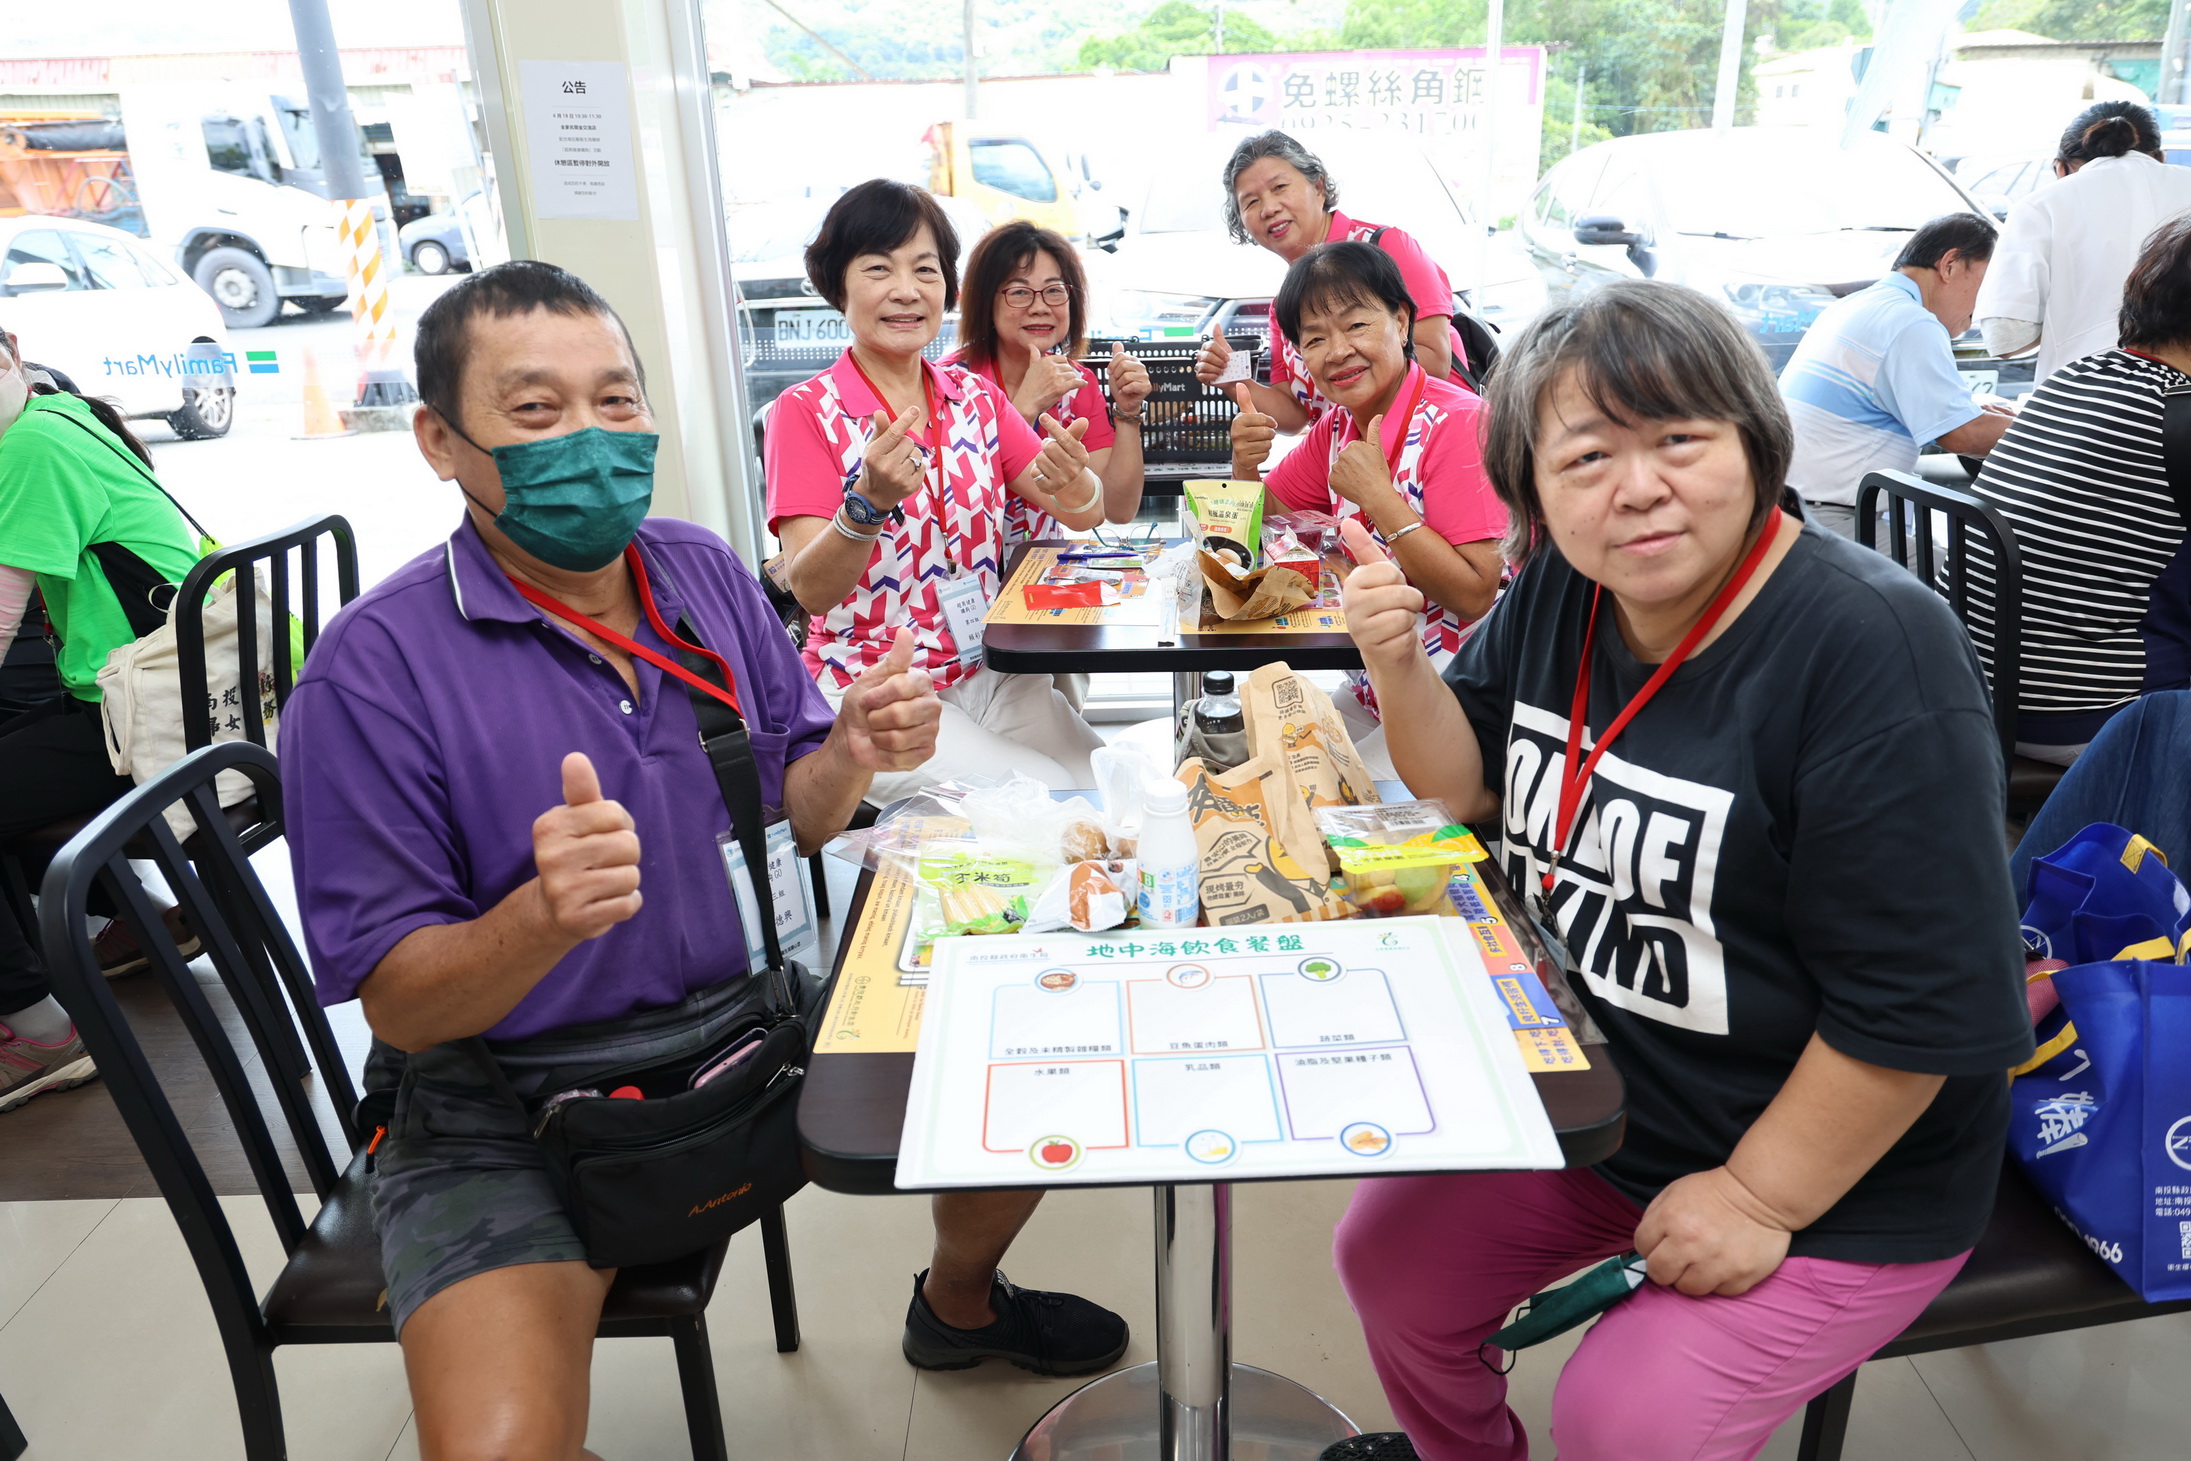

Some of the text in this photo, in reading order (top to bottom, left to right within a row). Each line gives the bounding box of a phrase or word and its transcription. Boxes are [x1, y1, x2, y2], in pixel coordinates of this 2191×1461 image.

[562, 80, 587, 95] 公告
[778, 318, 854, 341] BNJ-600
[1599, 798, 1691, 910] OF
[1086, 935, 1306, 959] 地中海飲食餐盤
[1169, 1040, 1229, 1050] 豆魚蛋肉類
[1034, 1067, 1070, 1076] 水果類
[1185, 1062, 1221, 1072] 乳品類
